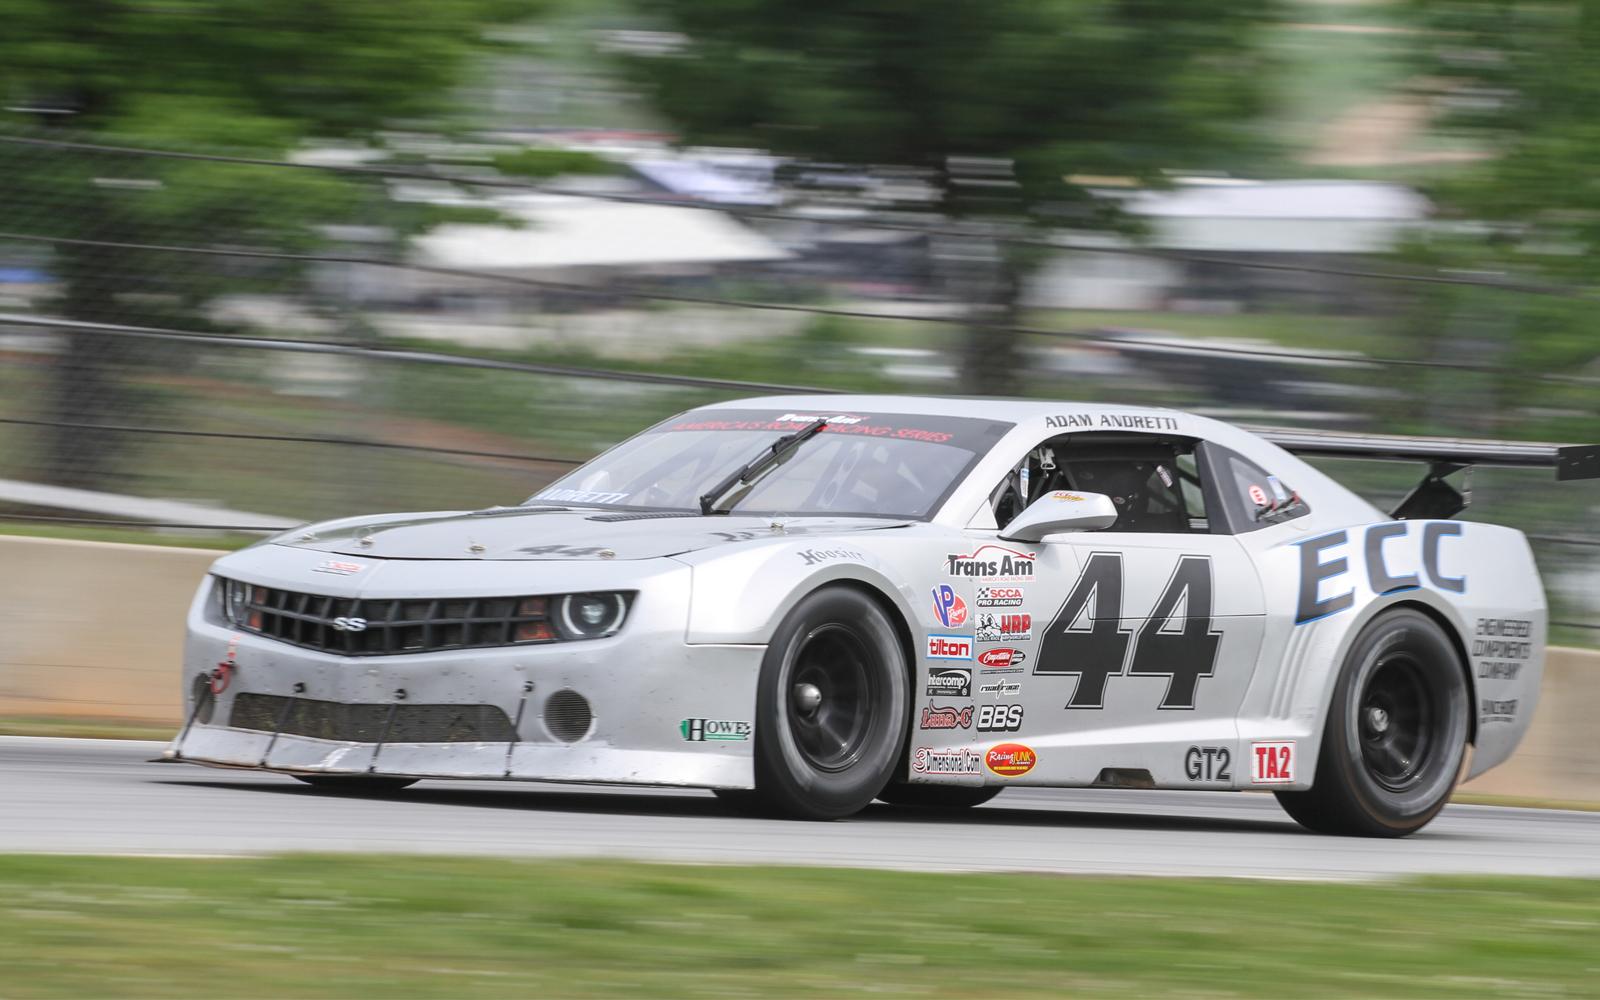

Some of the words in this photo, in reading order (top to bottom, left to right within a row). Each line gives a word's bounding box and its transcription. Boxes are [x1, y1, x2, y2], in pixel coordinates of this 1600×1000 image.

[1045, 414, 1093, 428] ADAM
[1100, 414, 1179, 430] ANDRETTI
[946, 554, 998, 577] Trans
[999, 554, 1034, 577] Am
[1291, 521, 1468, 626] ECC
[976, 599, 992, 607] PRO
[993, 599, 1021, 607] RACING
[989, 588, 1022, 599] SCCA
[931, 584, 955, 628] VP
[332, 617, 368, 632] SS
[1032, 551, 1224, 710] 44
[929, 638, 969, 657] tilton
[976, 705, 1023, 731] BBS
[1185, 746, 1231, 780] GT2
[1255, 746, 1291, 778] TA2
